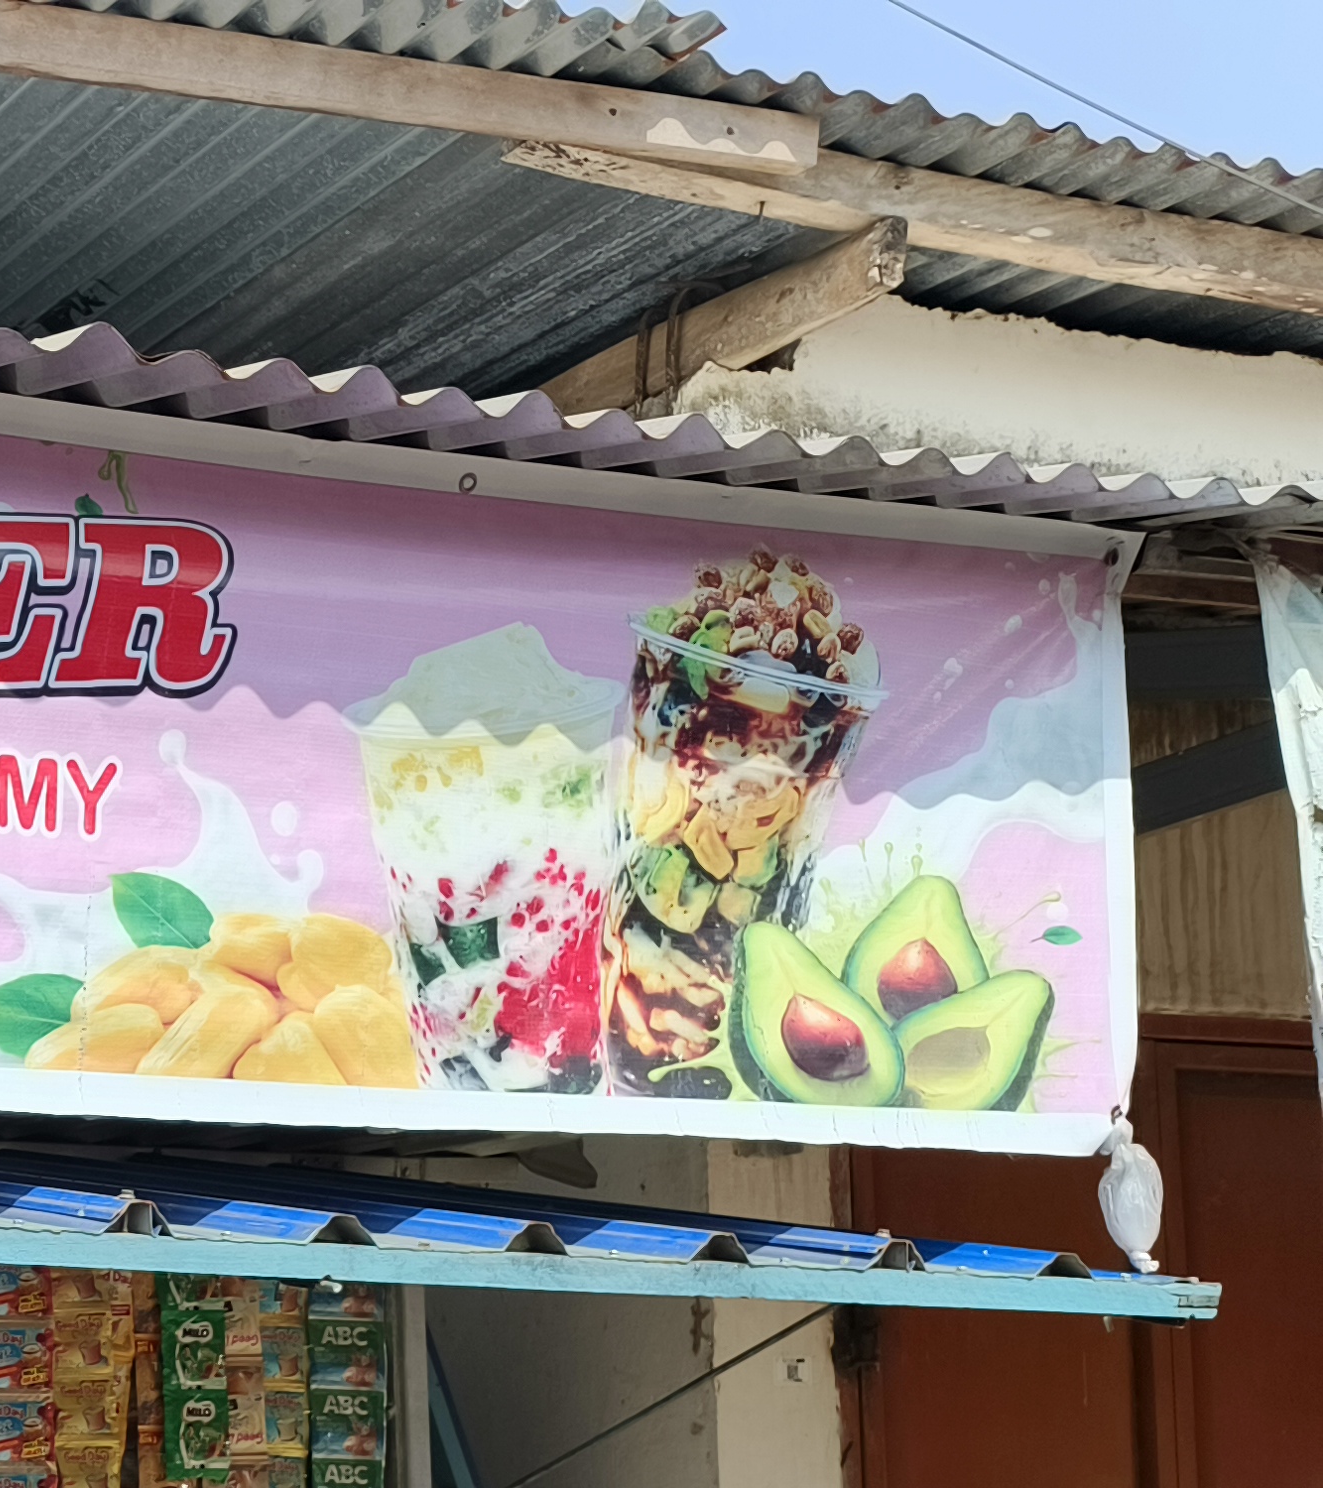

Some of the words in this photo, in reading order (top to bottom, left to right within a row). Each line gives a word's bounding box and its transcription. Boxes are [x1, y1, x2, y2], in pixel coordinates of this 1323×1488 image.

[182, 1328, 209, 1338] MILO
[321, 1326, 369, 1346] ABC
[186, 1407, 211, 1417] MILO
[322, 1395, 369, 1415] ABC
[324, 1465, 368, 1485] ABC
